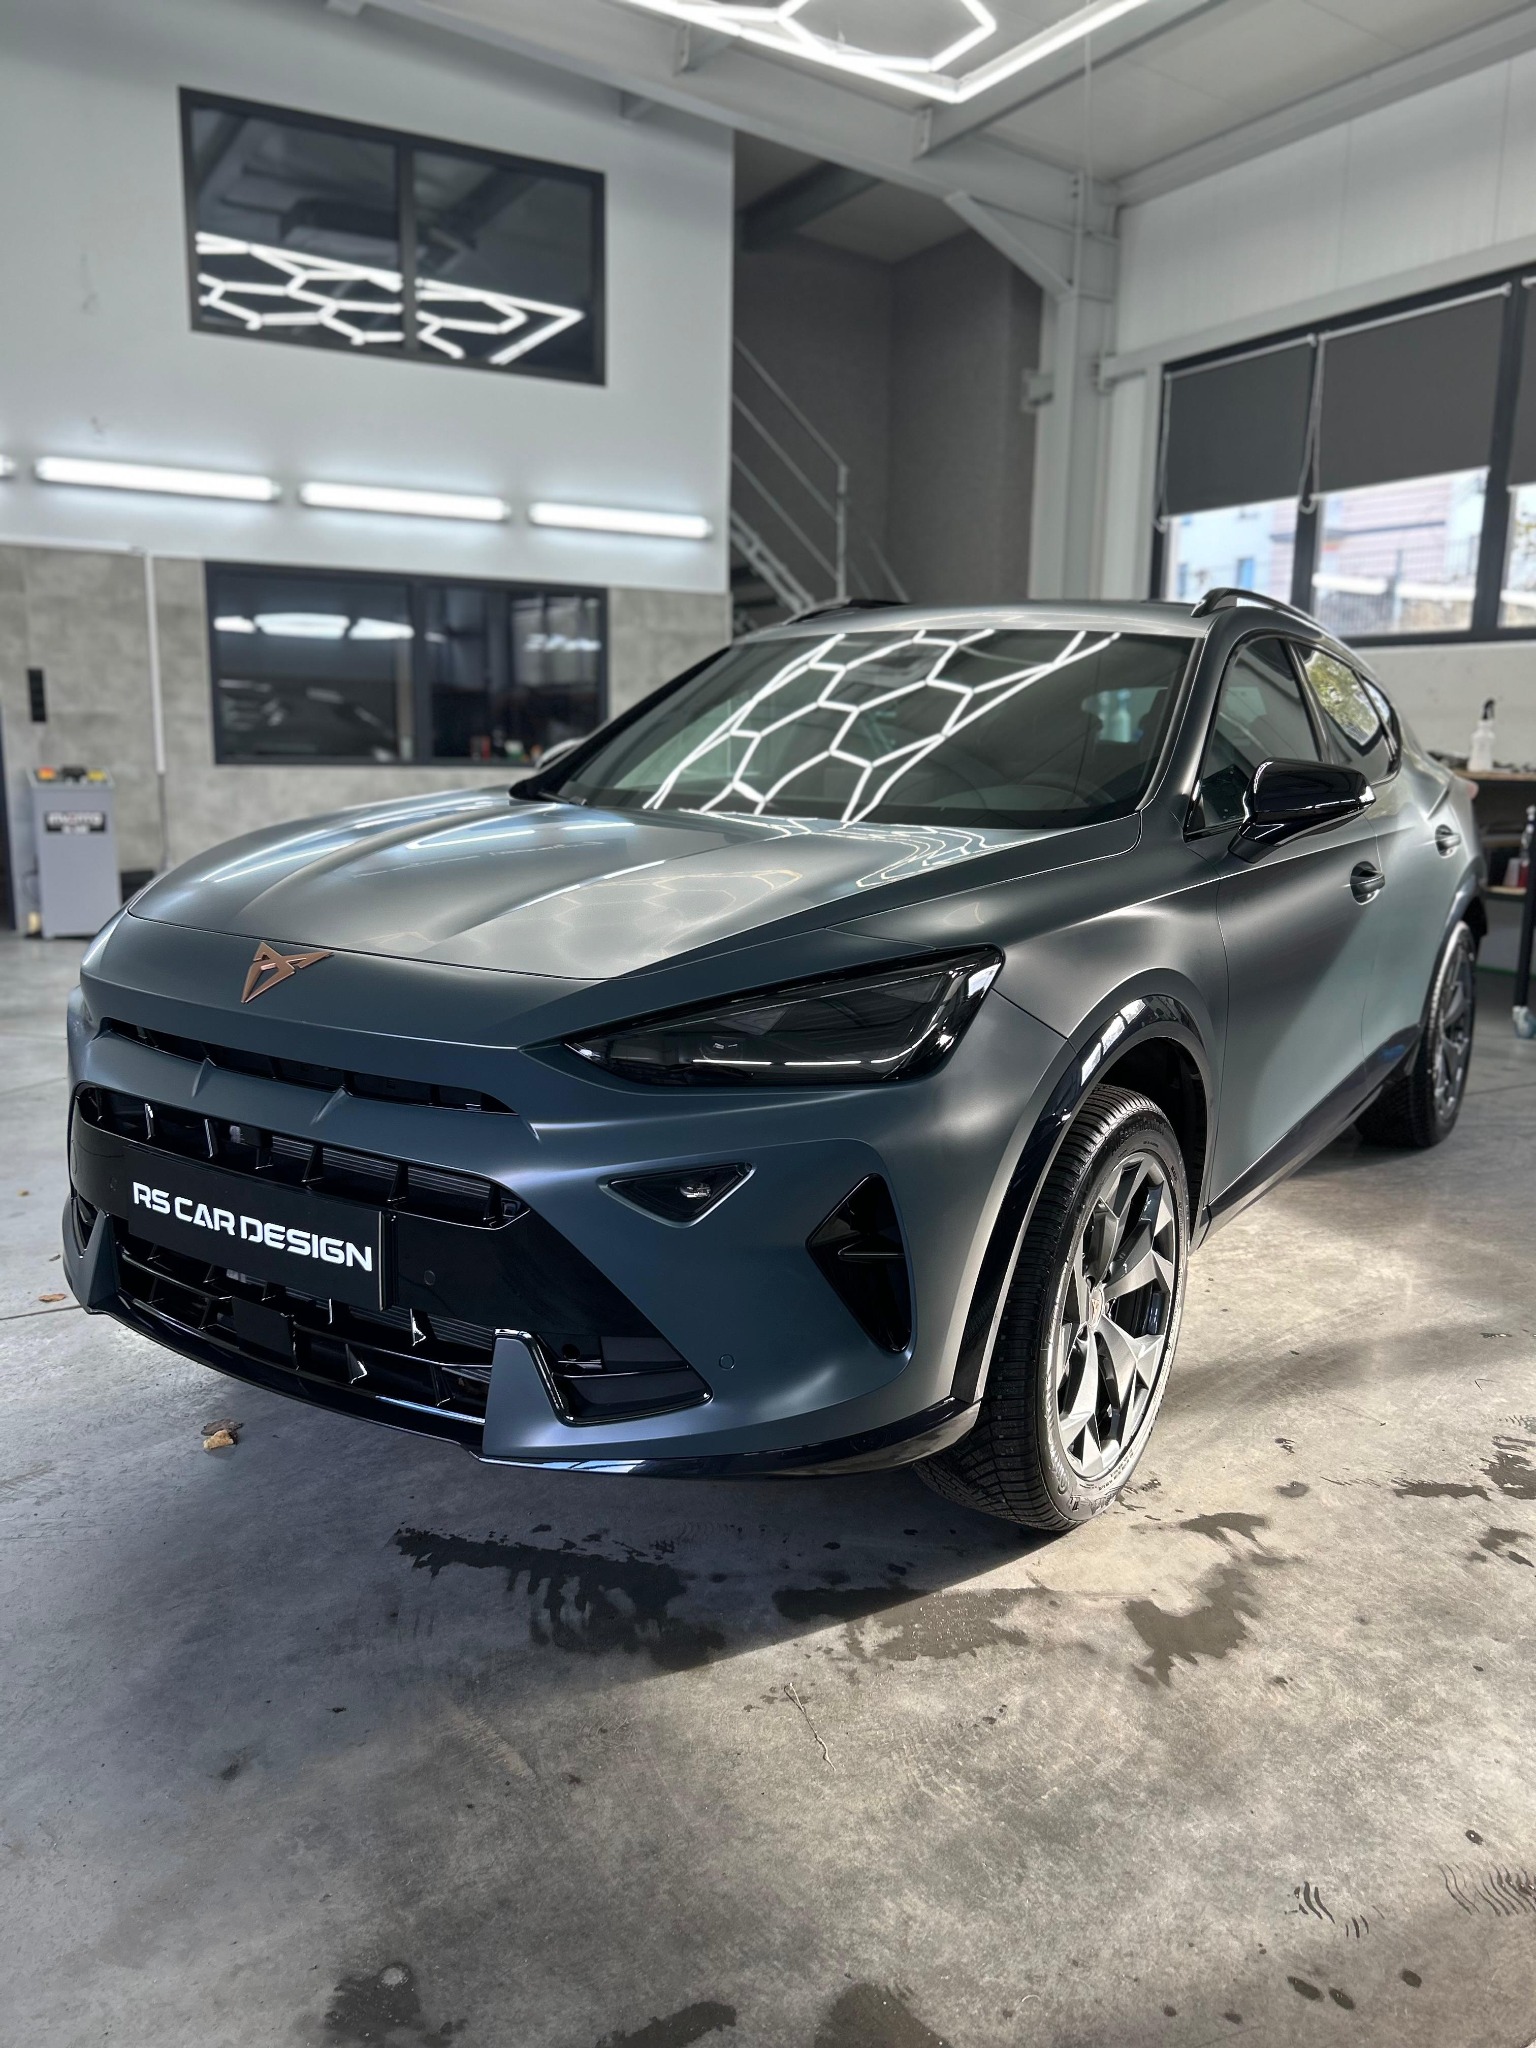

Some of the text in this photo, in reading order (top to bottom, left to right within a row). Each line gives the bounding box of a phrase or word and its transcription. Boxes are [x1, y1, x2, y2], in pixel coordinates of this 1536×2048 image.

[132, 1181, 373, 1272] RS CAR DESIGN
